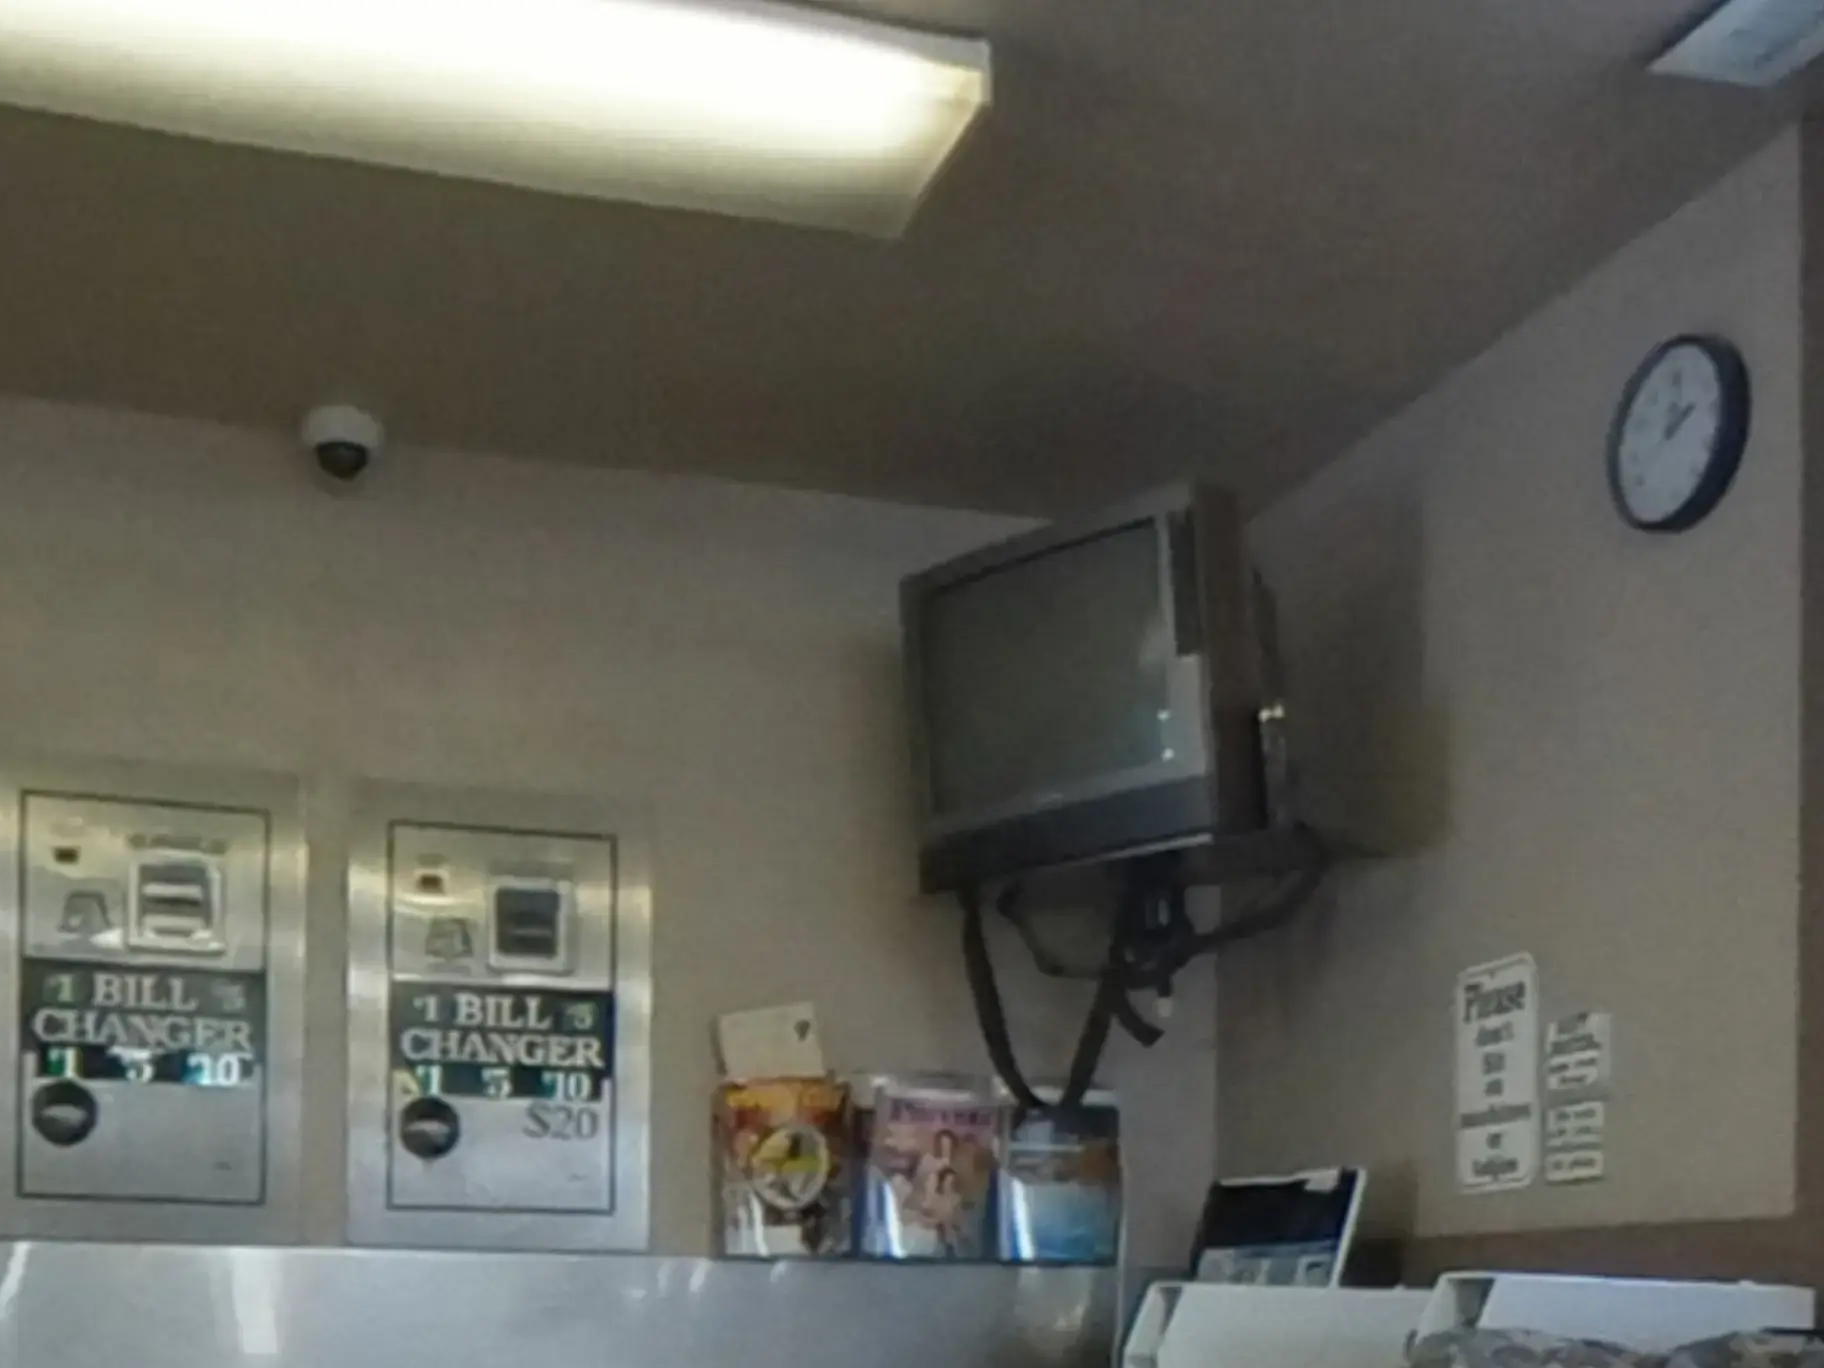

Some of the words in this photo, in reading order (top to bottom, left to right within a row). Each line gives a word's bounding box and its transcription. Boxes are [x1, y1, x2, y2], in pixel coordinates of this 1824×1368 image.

[93, 972, 198, 1010] BILL
[1463, 980, 1526, 1024] Please
[32, 1008, 253, 1052] CHANGER
[454, 993, 552, 1029] BILL
[401, 1029, 605, 1068] CHANGER
[523, 1102, 599, 1141] $20
